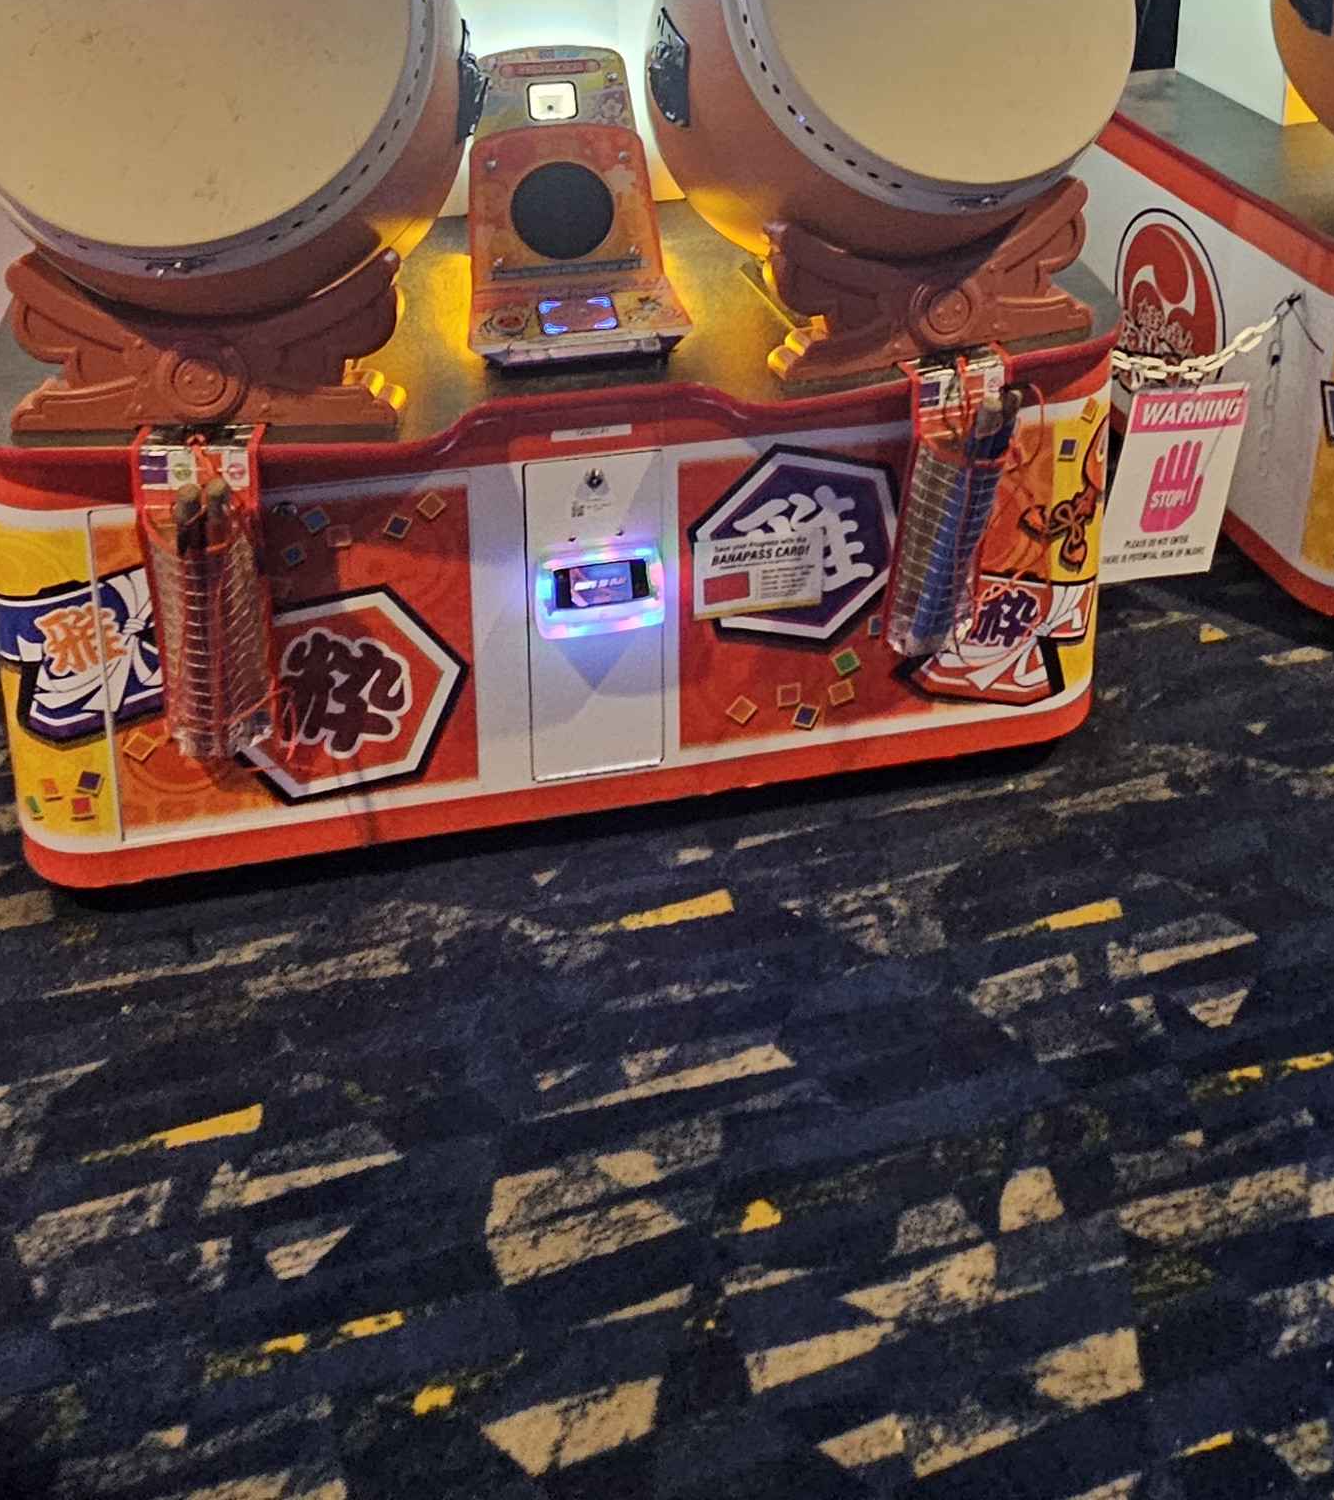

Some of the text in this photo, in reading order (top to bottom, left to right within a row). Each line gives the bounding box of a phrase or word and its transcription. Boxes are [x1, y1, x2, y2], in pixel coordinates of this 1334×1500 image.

[1141, 397, 1241, 426] WARNING
[1150, 489, 1187, 509] STOP!
[711, 545, 811, 566] BANAPASS CARD!
